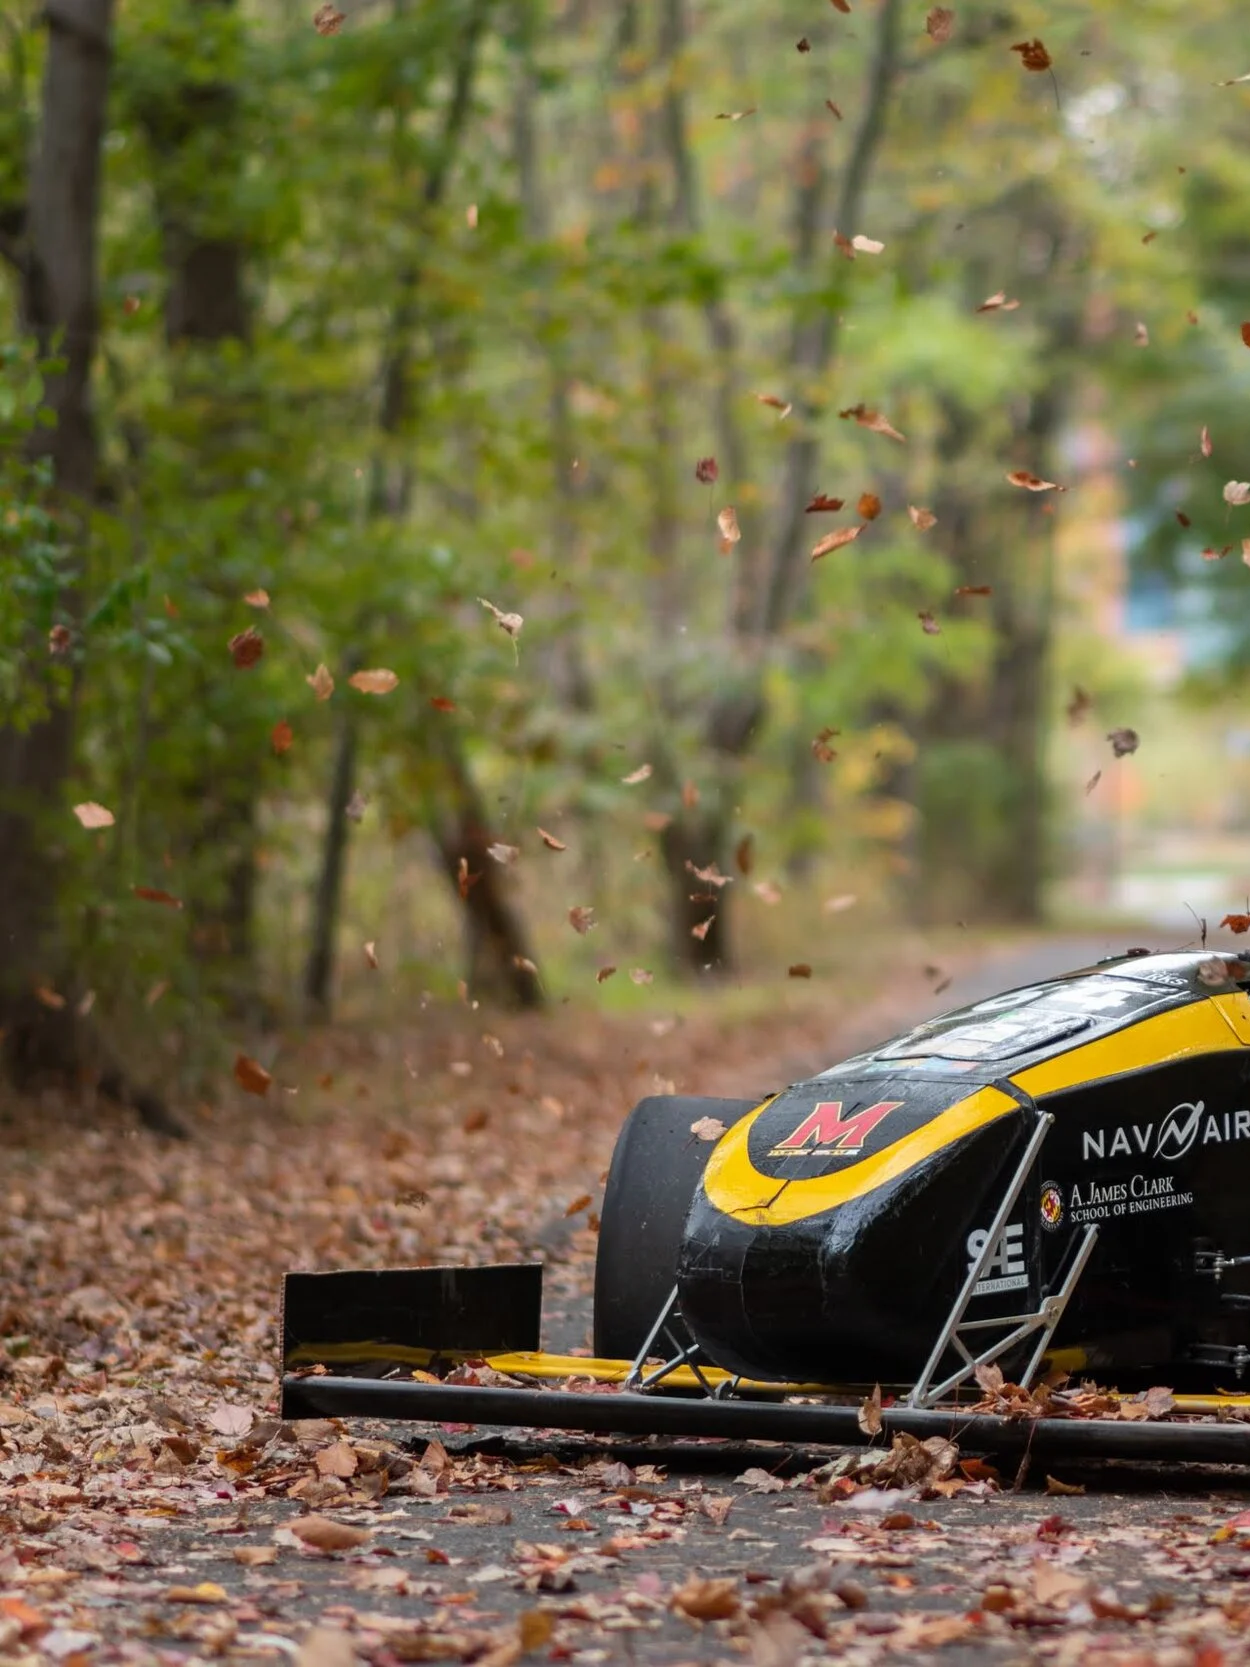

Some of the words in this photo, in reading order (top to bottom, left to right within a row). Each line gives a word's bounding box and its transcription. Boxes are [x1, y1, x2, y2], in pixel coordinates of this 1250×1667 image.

[774, 1101, 906, 1149] M
[1070, 1205, 1111, 1223] SCHOOL
[1113, 1202, 1127, 1216] OF
[1129, 1192, 1194, 1213] ENGINEERING
[1087, 1181, 1128, 1206] JAMES
[1130, 1174, 1175, 1198] CLARK
[967, 1223, 1025, 1279] SAE
